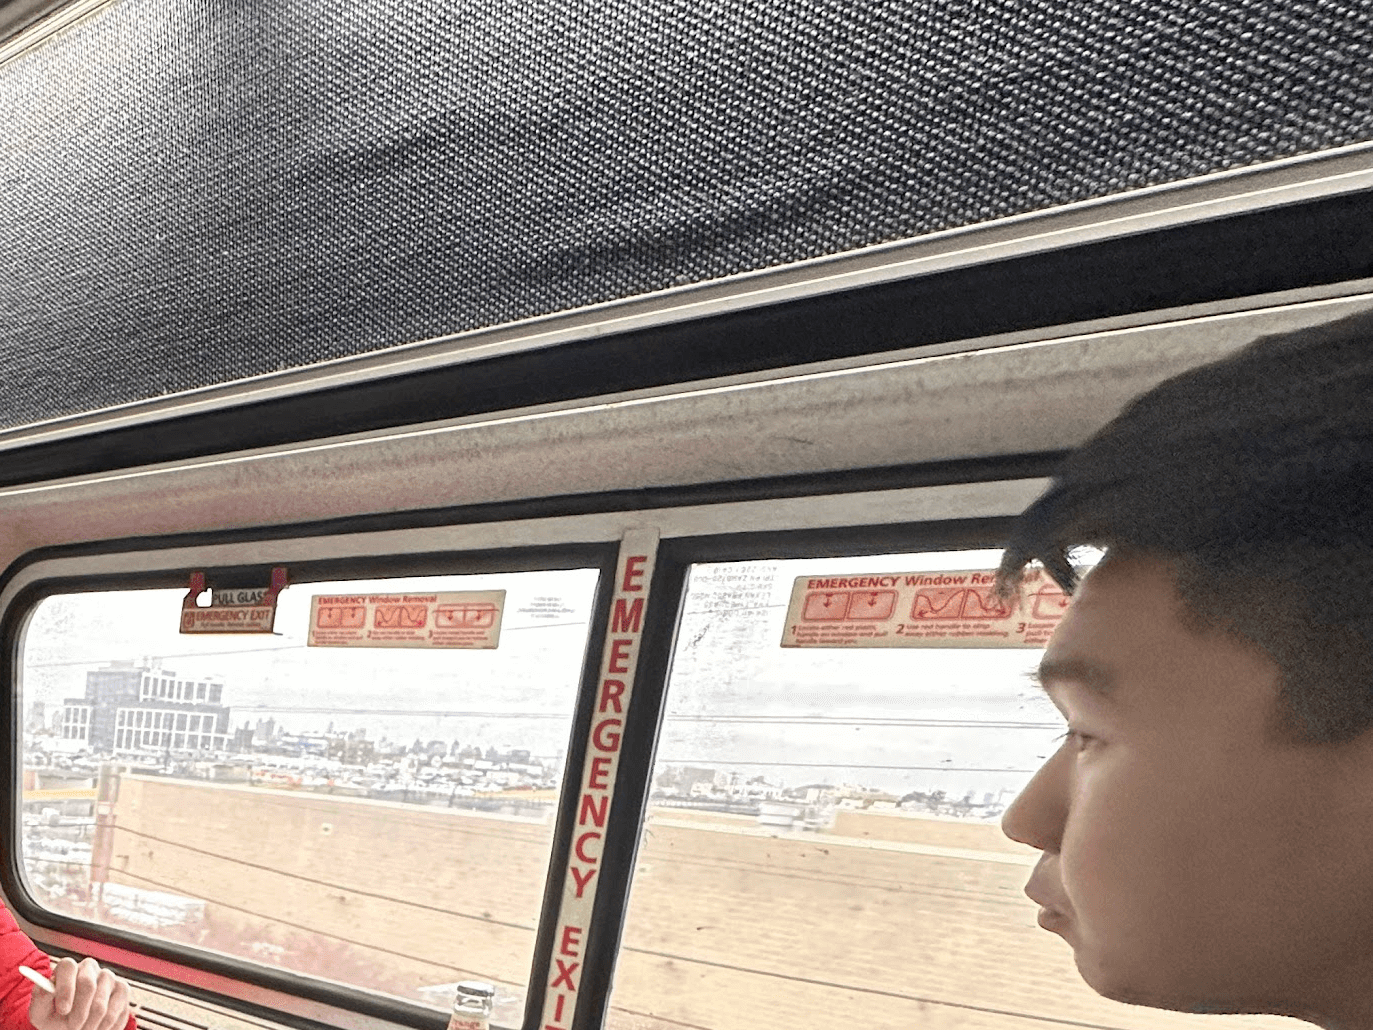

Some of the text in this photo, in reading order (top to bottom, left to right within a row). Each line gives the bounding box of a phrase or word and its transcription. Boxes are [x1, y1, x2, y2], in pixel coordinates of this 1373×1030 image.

[807, 576, 901, 589] EMERGENCY
[905, 573, 967, 586] Window
[237, 590, 268, 604] GLAS
[318, 597, 367, 605] EMERGENCY
[369, 595, 401, 604] Window
[196, 608, 270, 621] EMERGENCY EXIT
[895, 623, 905, 635] 2
[1015, 622, 1026, 634] 3
[570, 555, 648, 899] EMERGENCY
